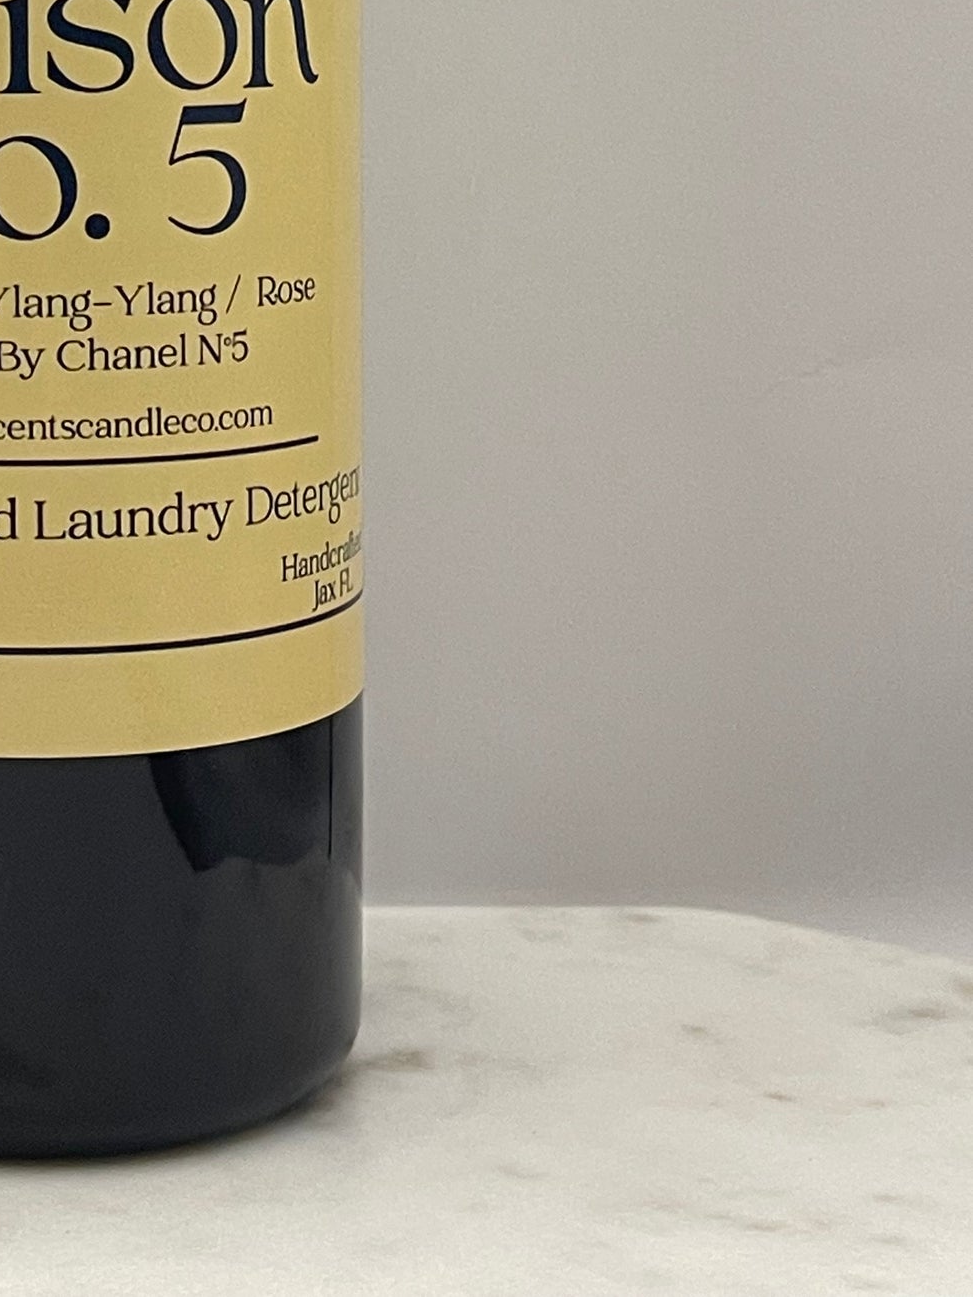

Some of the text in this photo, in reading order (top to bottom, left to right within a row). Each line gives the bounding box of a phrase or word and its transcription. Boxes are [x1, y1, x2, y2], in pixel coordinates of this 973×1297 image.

[168, 98, 247, 235] 5
[226, 274, 241, 313] /
[258, 276, 315, 307] Rose
[56, 332, 188, 373] Chanel
[35, 491, 234, 541] Laundry
[245, 465, 361, 525] Detergen
[312, 566, 355, 614] Jax FL
